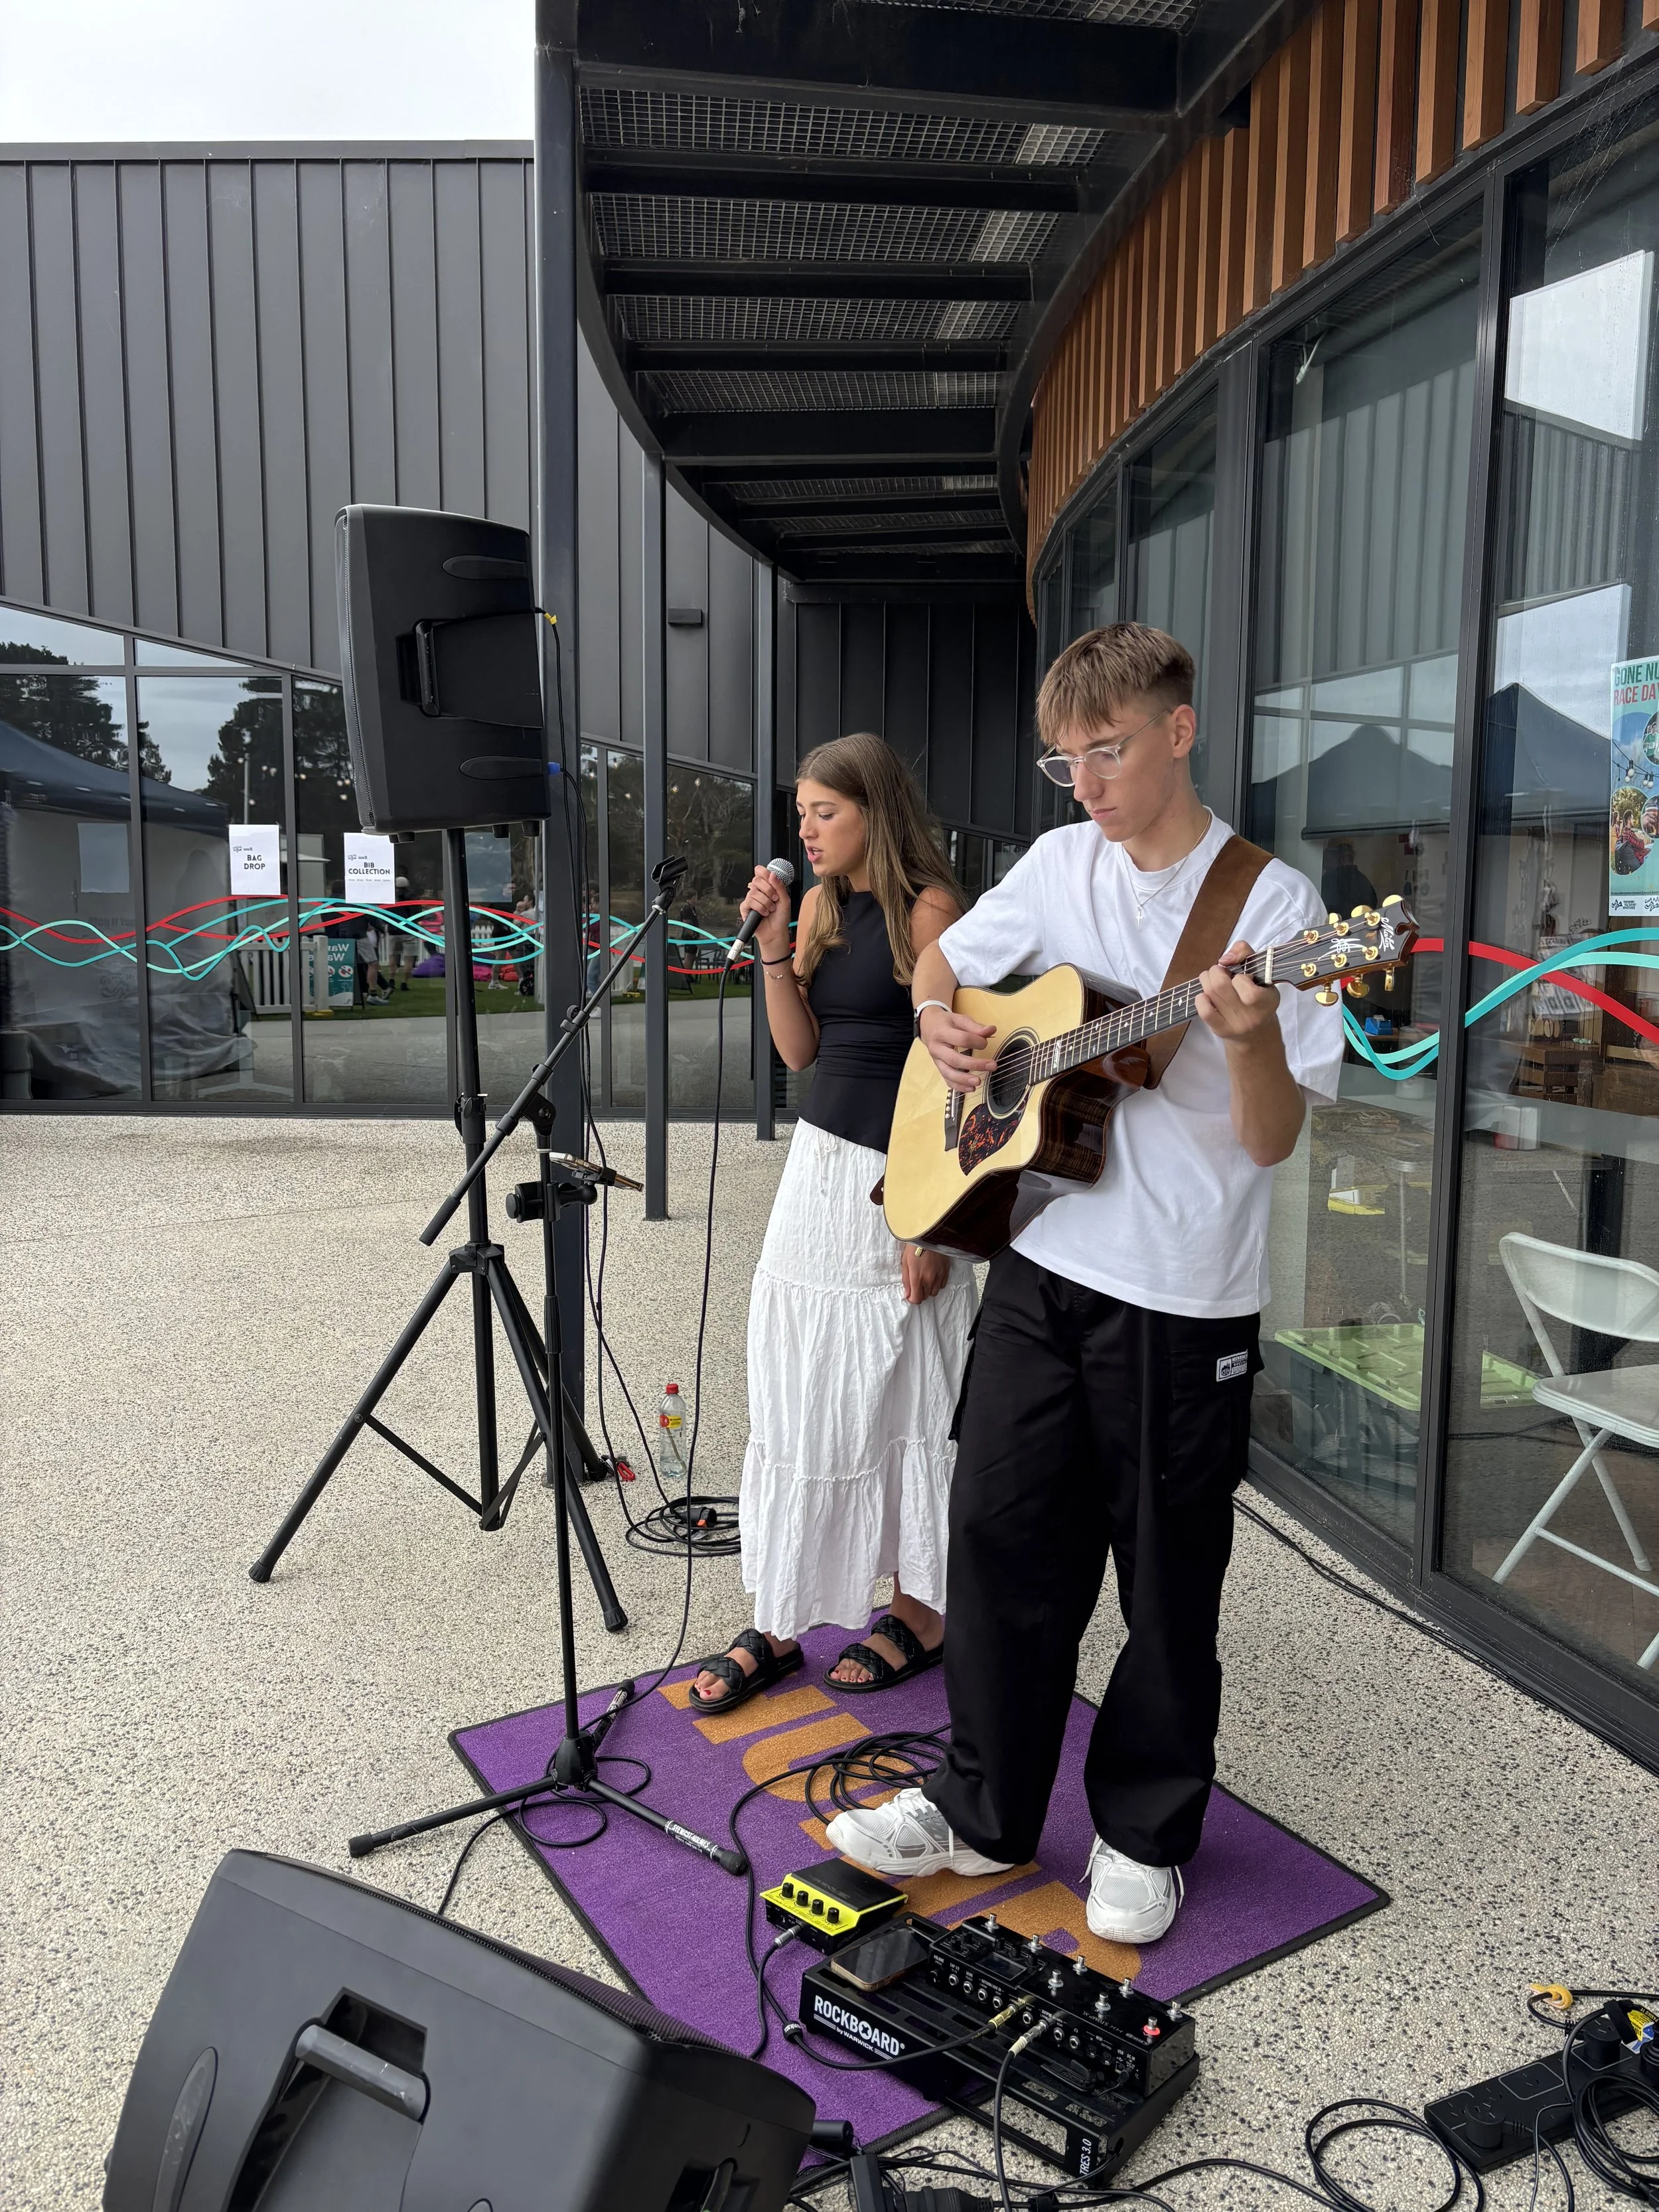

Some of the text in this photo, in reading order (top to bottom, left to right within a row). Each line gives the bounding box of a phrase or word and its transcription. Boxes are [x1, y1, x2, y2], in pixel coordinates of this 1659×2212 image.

[1615, 664, 1642, 686] GONE
[1614, 686, 1639, 705] RACE
[836, 2026, 874, 2052] by WARWICK
[1079, 2138, 1092, 2175] TRES 3.0
